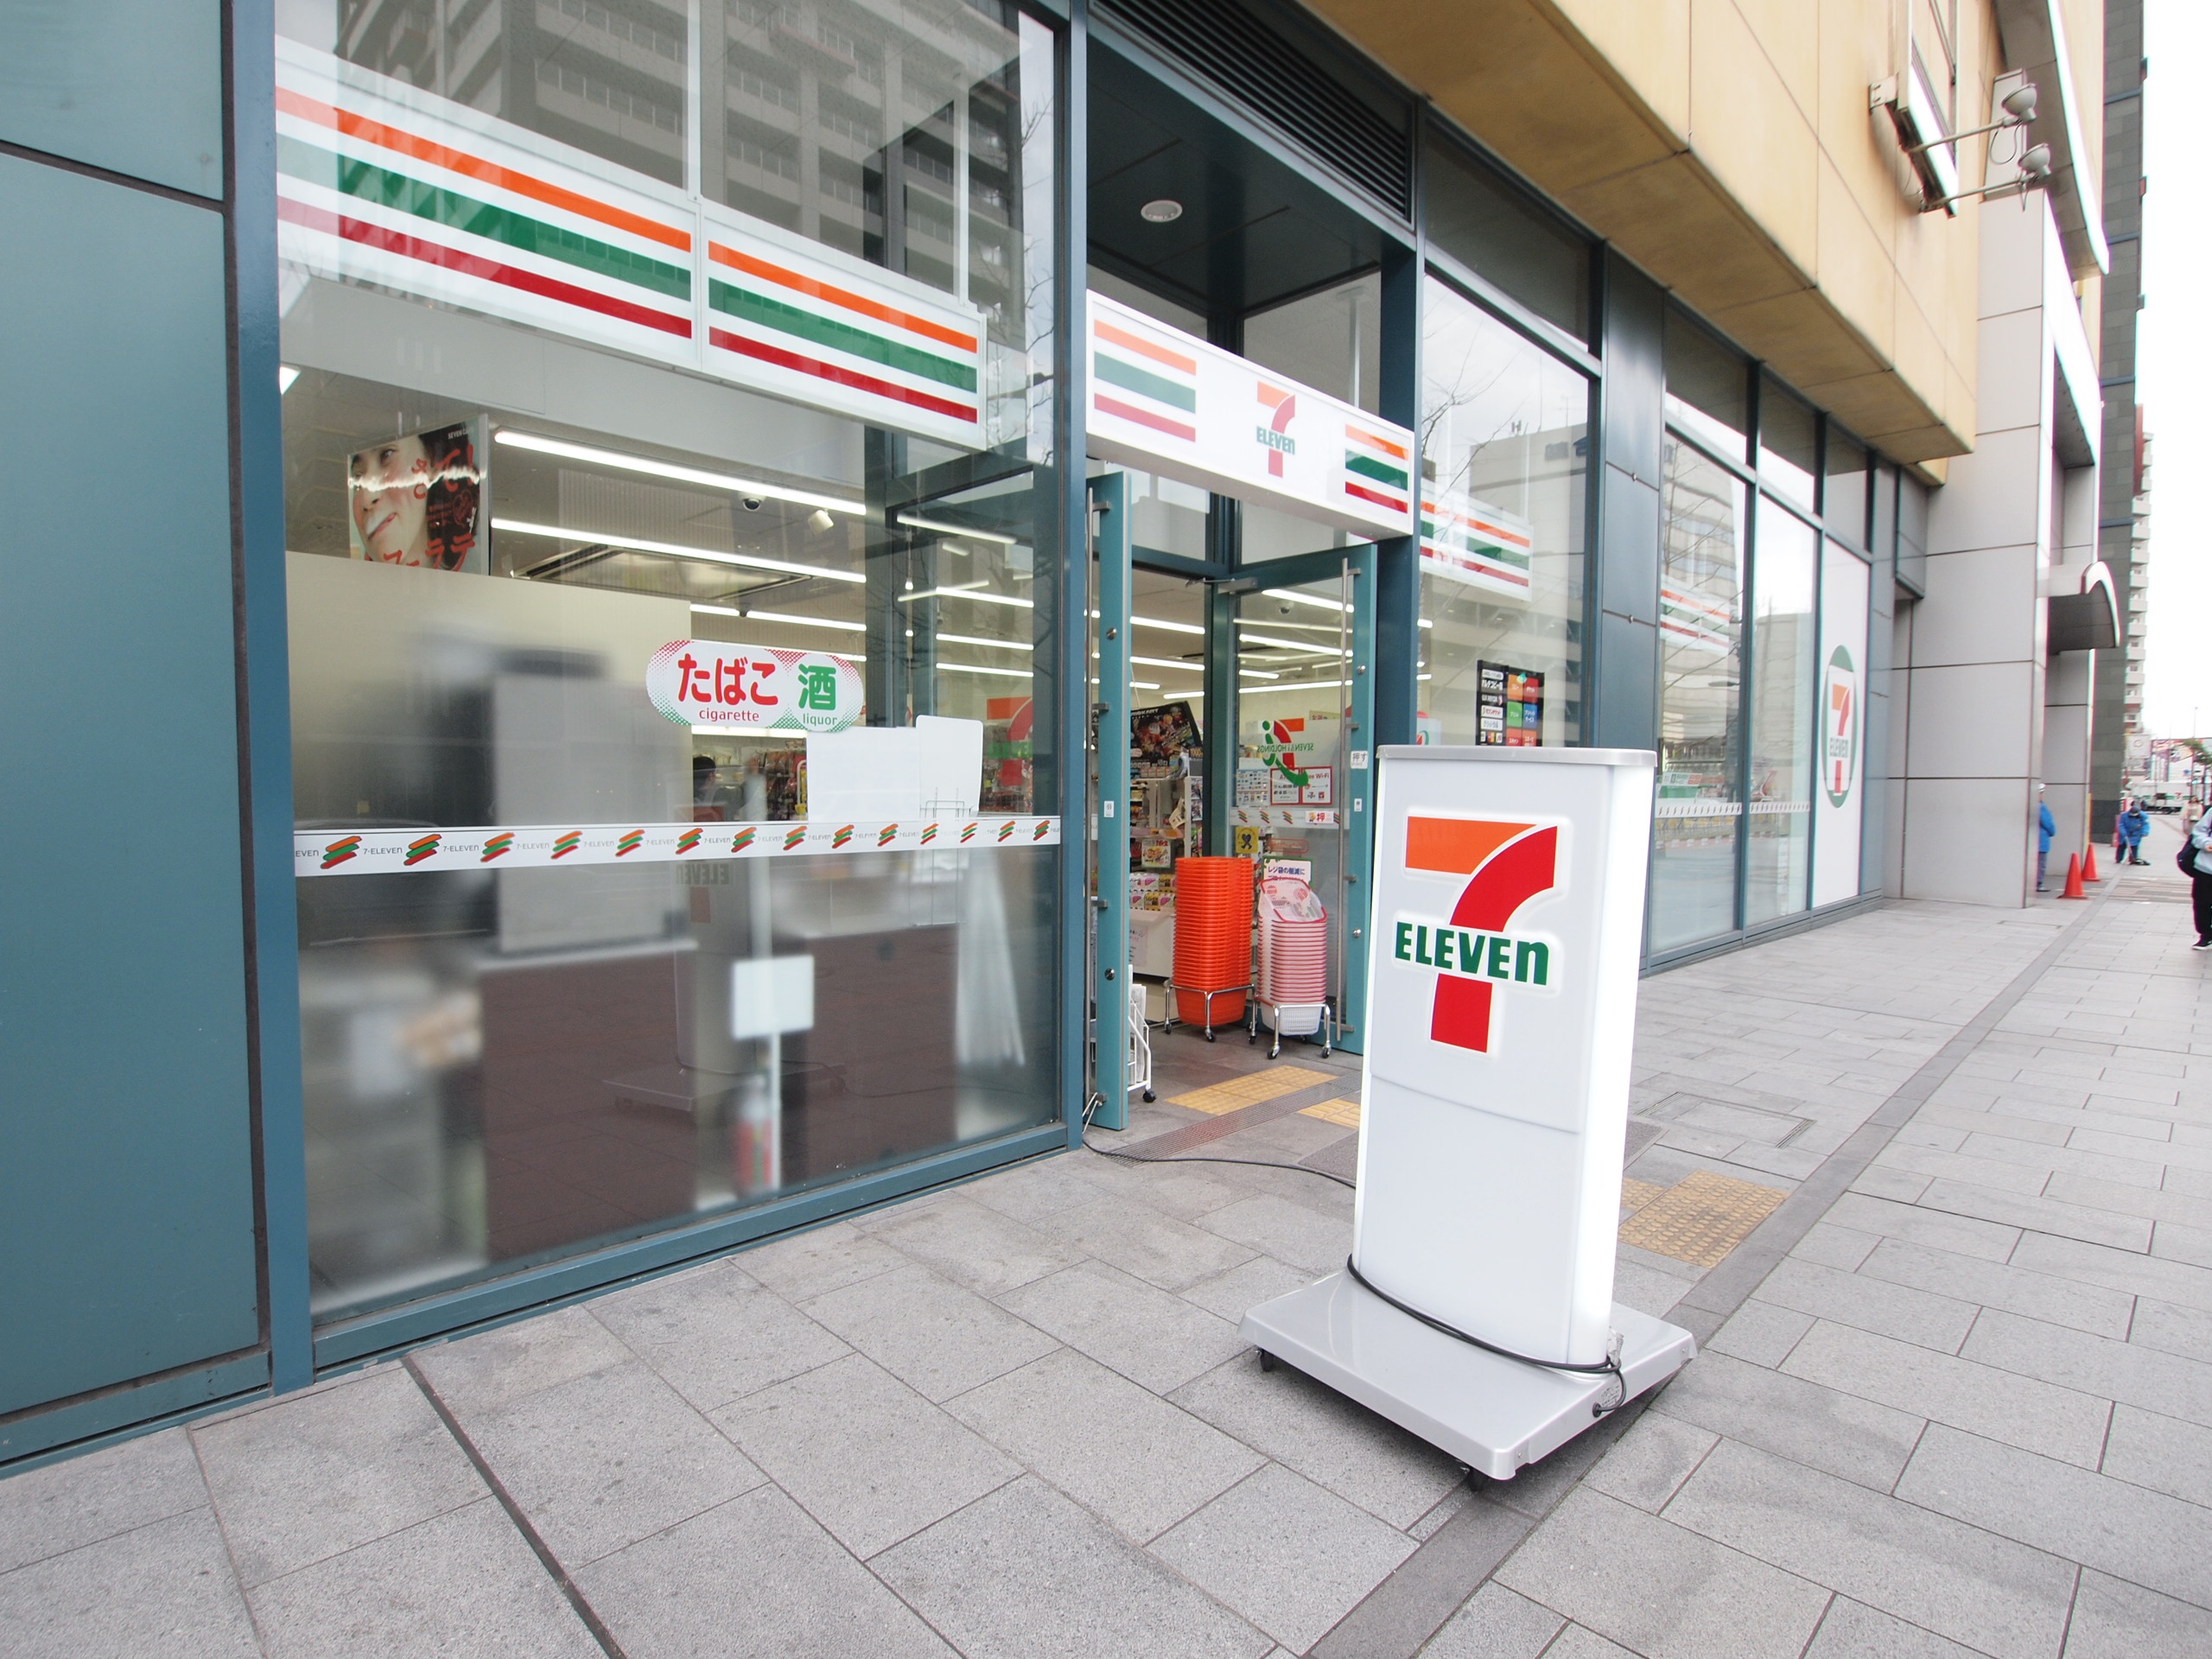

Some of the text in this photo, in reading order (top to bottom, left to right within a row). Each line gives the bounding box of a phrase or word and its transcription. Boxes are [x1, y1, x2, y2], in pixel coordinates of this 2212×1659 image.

[677, 653, 837, 711] たばこ 酒
[699, 708, 838, 727] cigarette liquor
[1405, 816, 1558, 1053] 7
